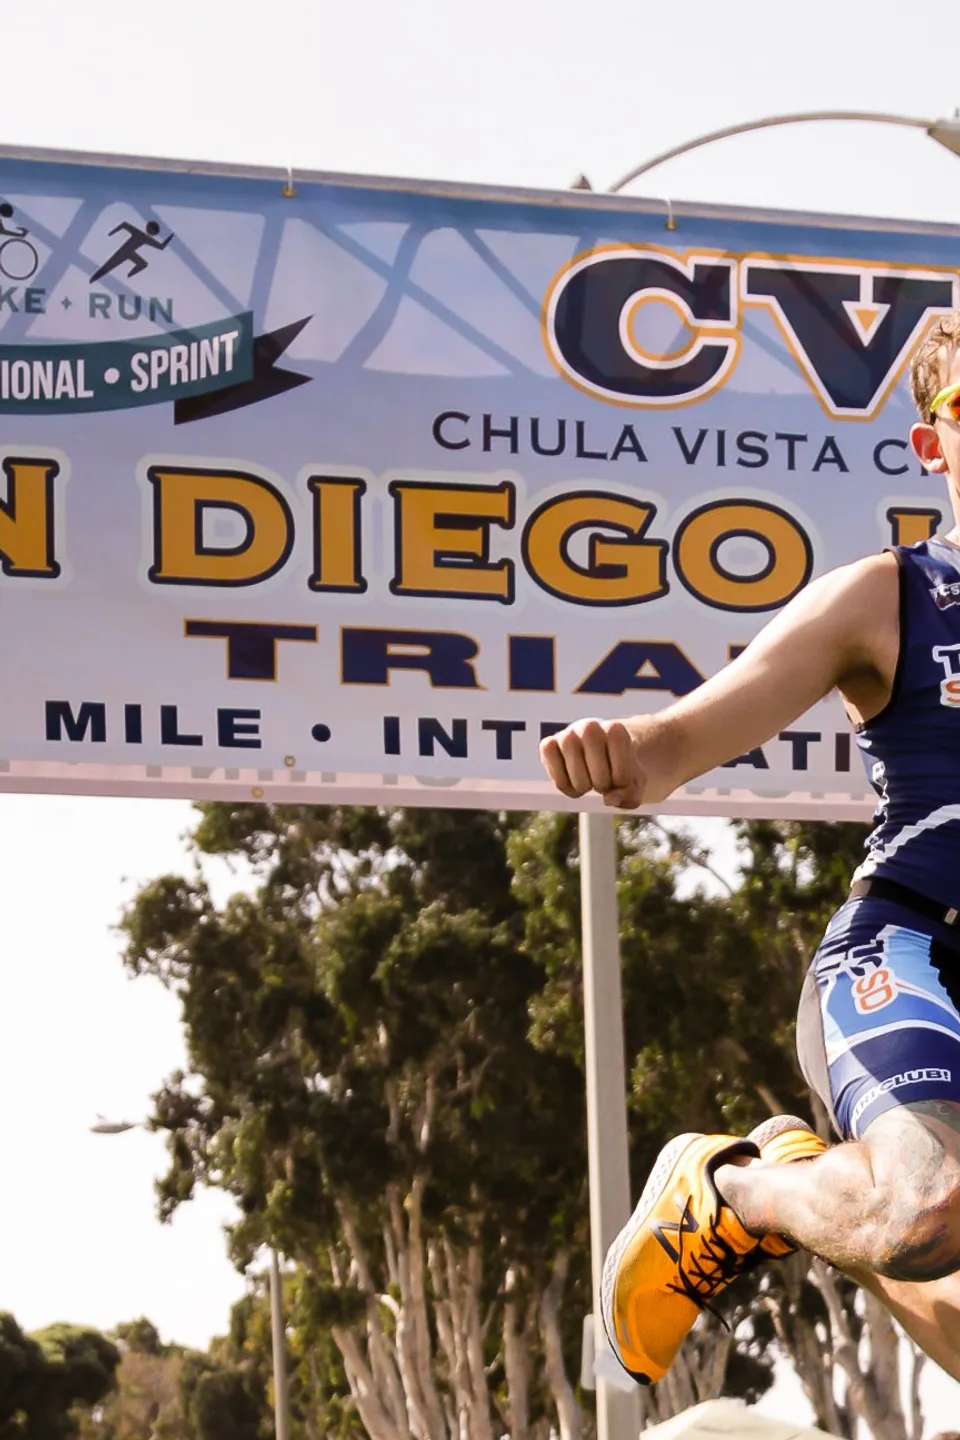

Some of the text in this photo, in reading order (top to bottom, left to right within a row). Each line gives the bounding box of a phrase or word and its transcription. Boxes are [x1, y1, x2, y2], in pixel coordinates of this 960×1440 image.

[89, 292, 174, 324] RUN
[130, 330, 239, 393] SPRINT
[432, 411, 643, 463] CHULA
[672, 428, 859, 475] VISTA
[146, 466, 814, 613] DIEGO
[45, 701, 263, 750] MILE
